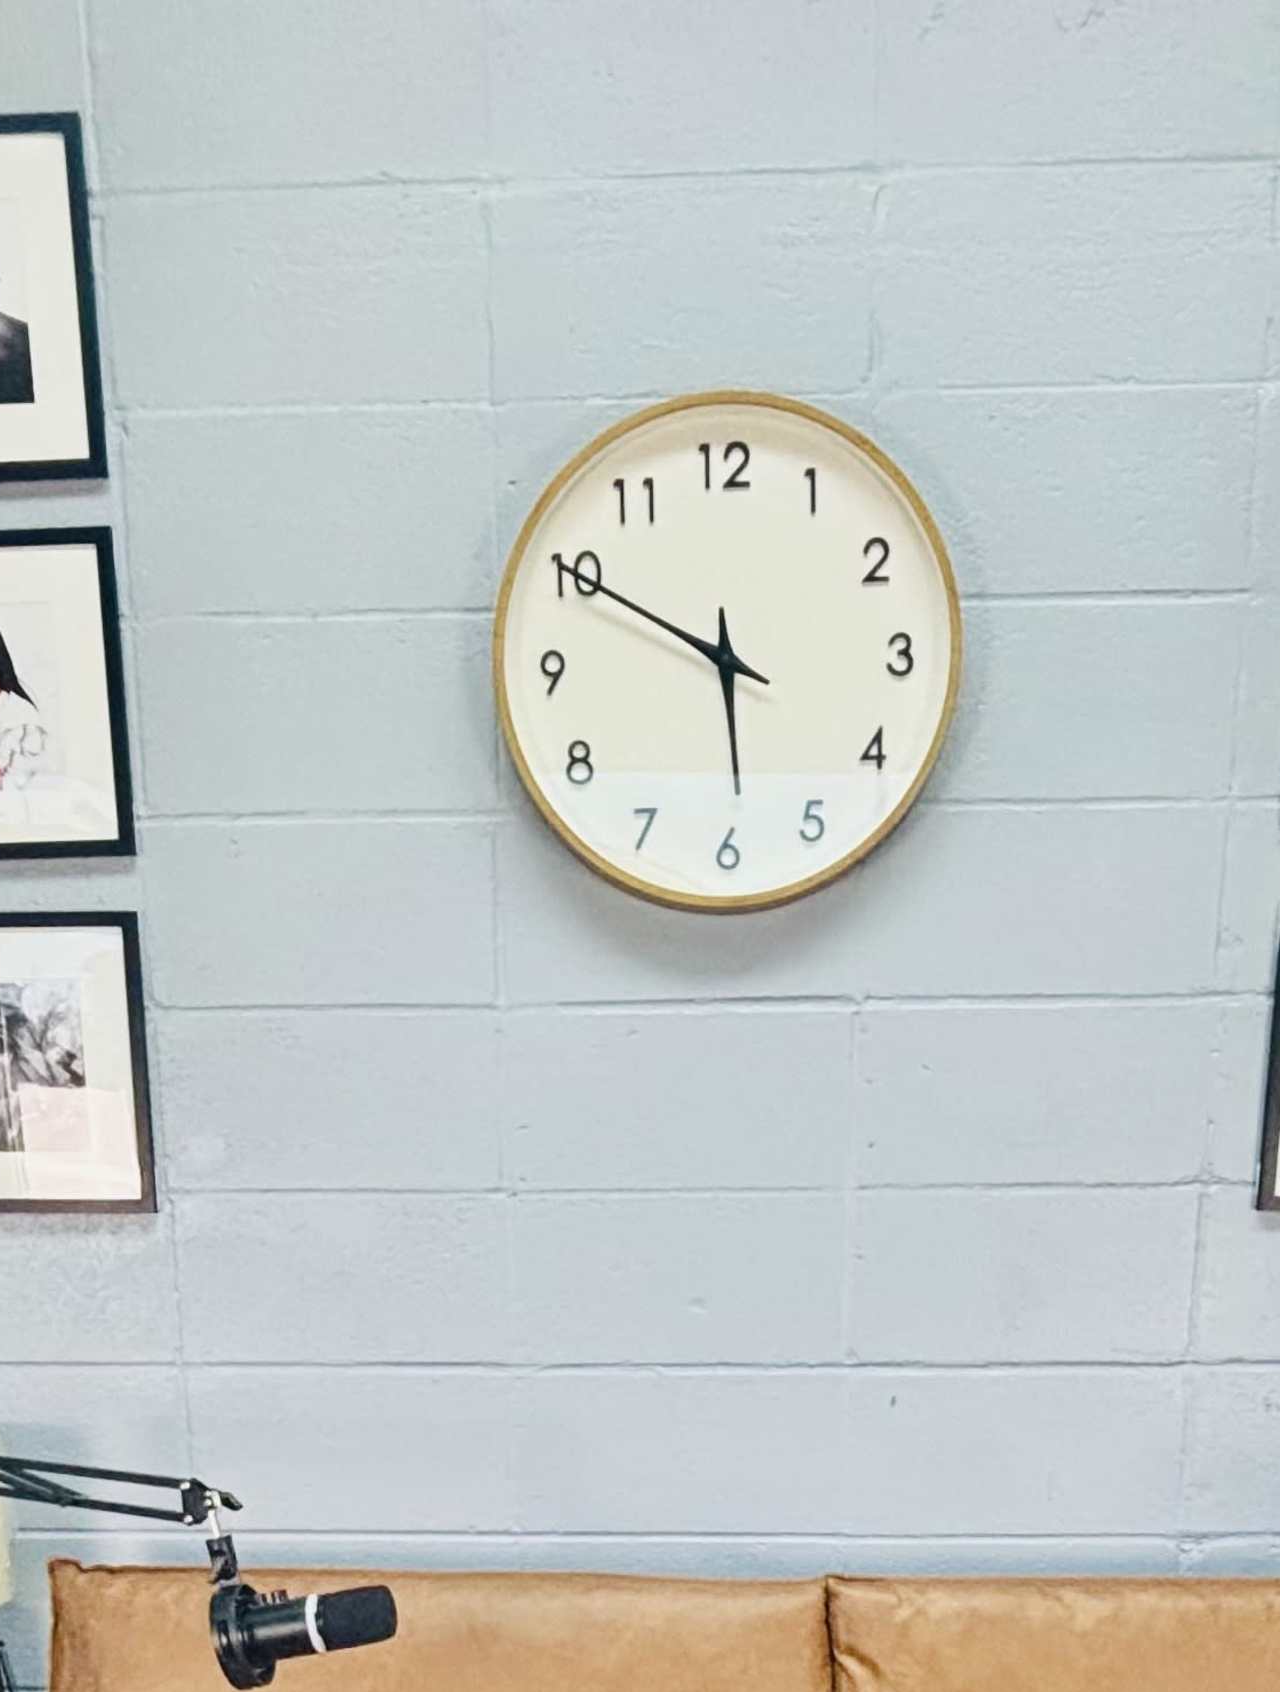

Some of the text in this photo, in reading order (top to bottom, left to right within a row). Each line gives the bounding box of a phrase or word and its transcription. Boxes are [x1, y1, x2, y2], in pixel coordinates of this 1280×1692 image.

[697, 440, 751, 491] 12
[612, 477, 656, 526] 11
[804, 466, 817, 516] 1
[551, 550, 602, 598] 10
[861, 536, 891, 585] 2
[540, 650, 566, 696] 9
[886, 632, 915, 678] 3
[565, 740, 594, 785] 8
[859, 725, 888, 771] 4
[633, 807, 659, 851] 7
[799, 799, 826, 843] 5
[715, 826, 741, 871] 6
